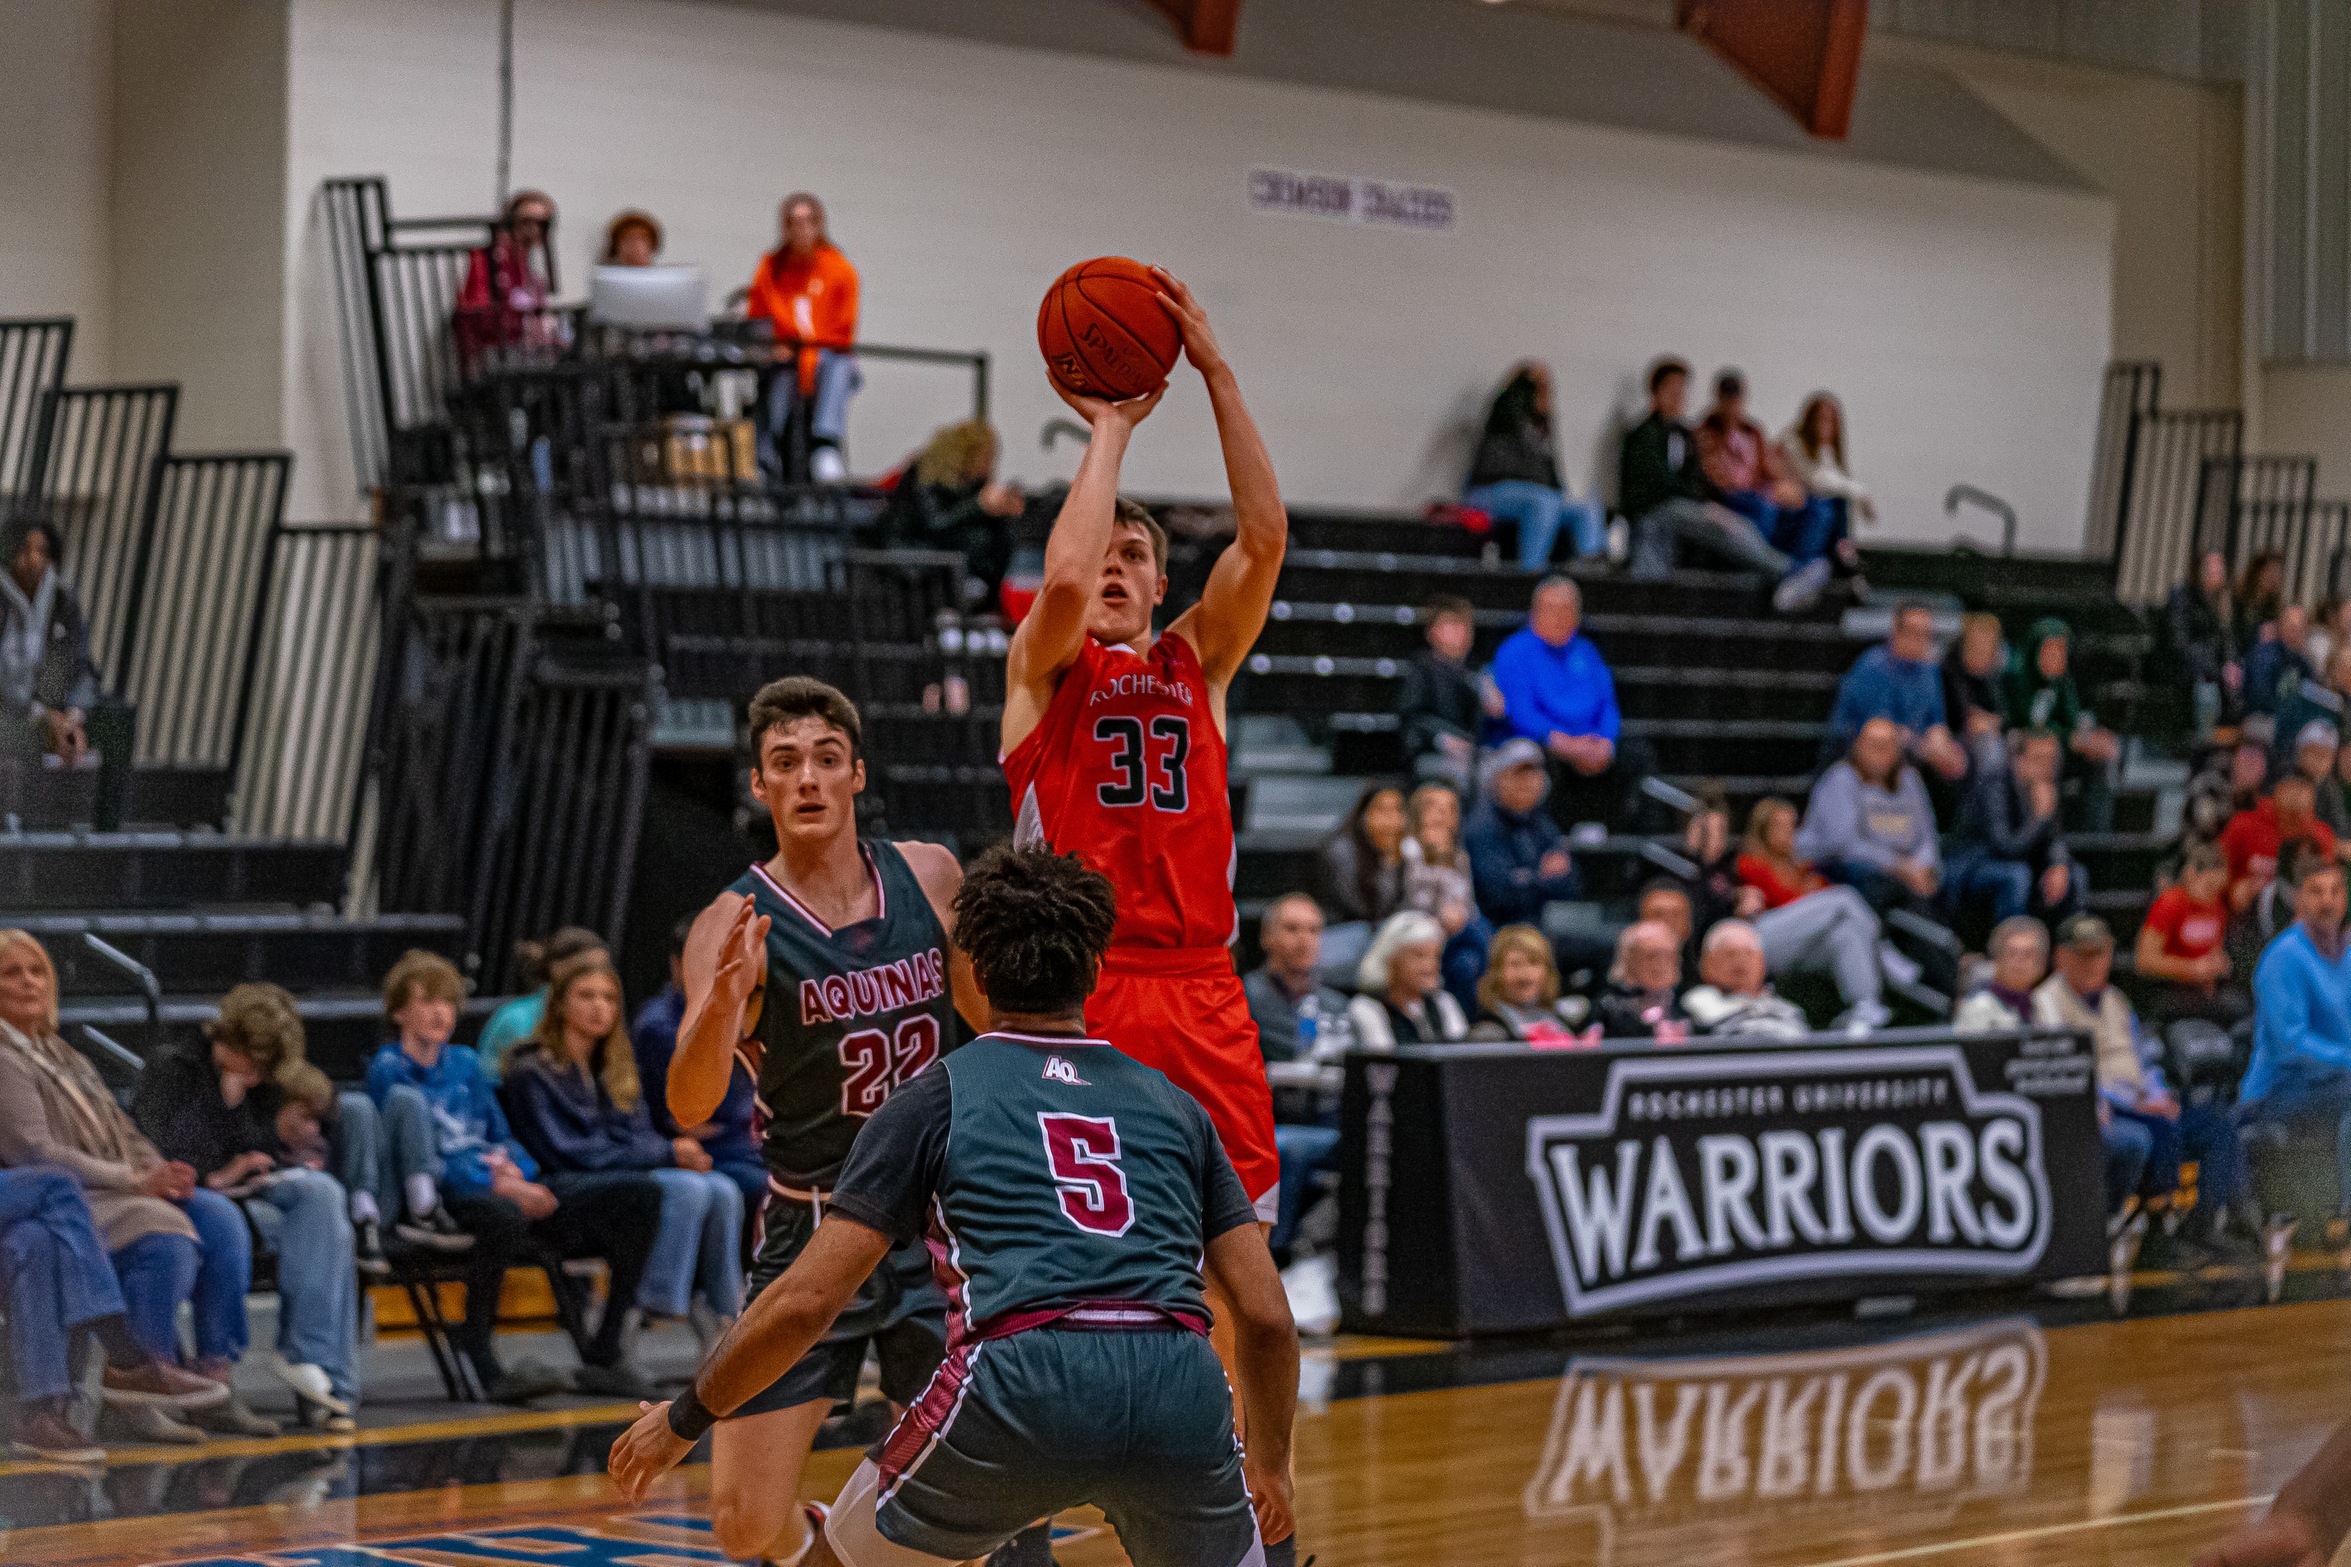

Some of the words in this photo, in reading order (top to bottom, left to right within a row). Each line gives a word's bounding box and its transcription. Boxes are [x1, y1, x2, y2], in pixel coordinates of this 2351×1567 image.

[1093, 714, 1191, 813] 33
[800, 947, 945, 1026] AQUINAS
[838, 1013, 940, 1117] 22
[1042, 1055, 1092, 1085] AQ
[1628, 1084, 1784, 1121] ROCHESTER
[1792, 1077, 1948, 1114] UNIVERSITY
[1037, 1111, 1136, 1238] 5
[1548, 1116, 2036, 1286] WARRIORS
